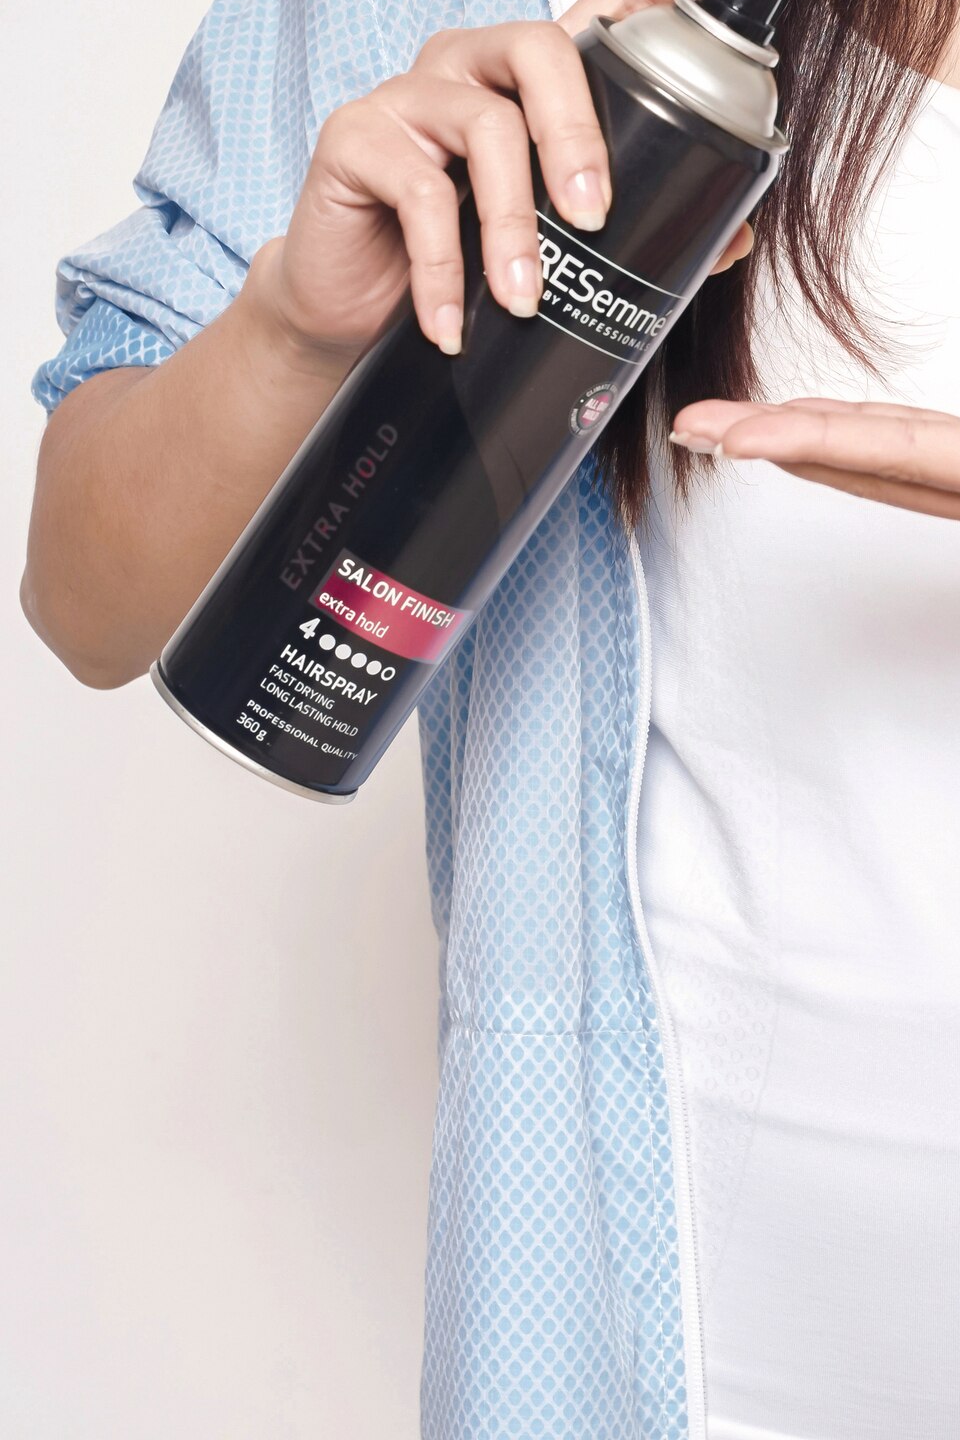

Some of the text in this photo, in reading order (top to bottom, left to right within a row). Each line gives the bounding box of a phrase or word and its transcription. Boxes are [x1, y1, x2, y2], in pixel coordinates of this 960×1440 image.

[537, 232, 673, 337] RESemmé
[542, 289, 651, 351] BY PROFESSIONALS
[279, 424, 398, 590] EXTRA HOLD
[319, 591, 390, 638] extra hold
[337, 558, 455, 628] SALON FINISH
[298, 617, 321, 640] 4
[269, 665, 336, 710] FAST DRYING
[280, 643, 378, 706] HAIRSPRAY
[246, 699, 358, 761] PROFESSIONAL QUALITY
[260, 677, 359, 737] LONG LASTING HOLD
